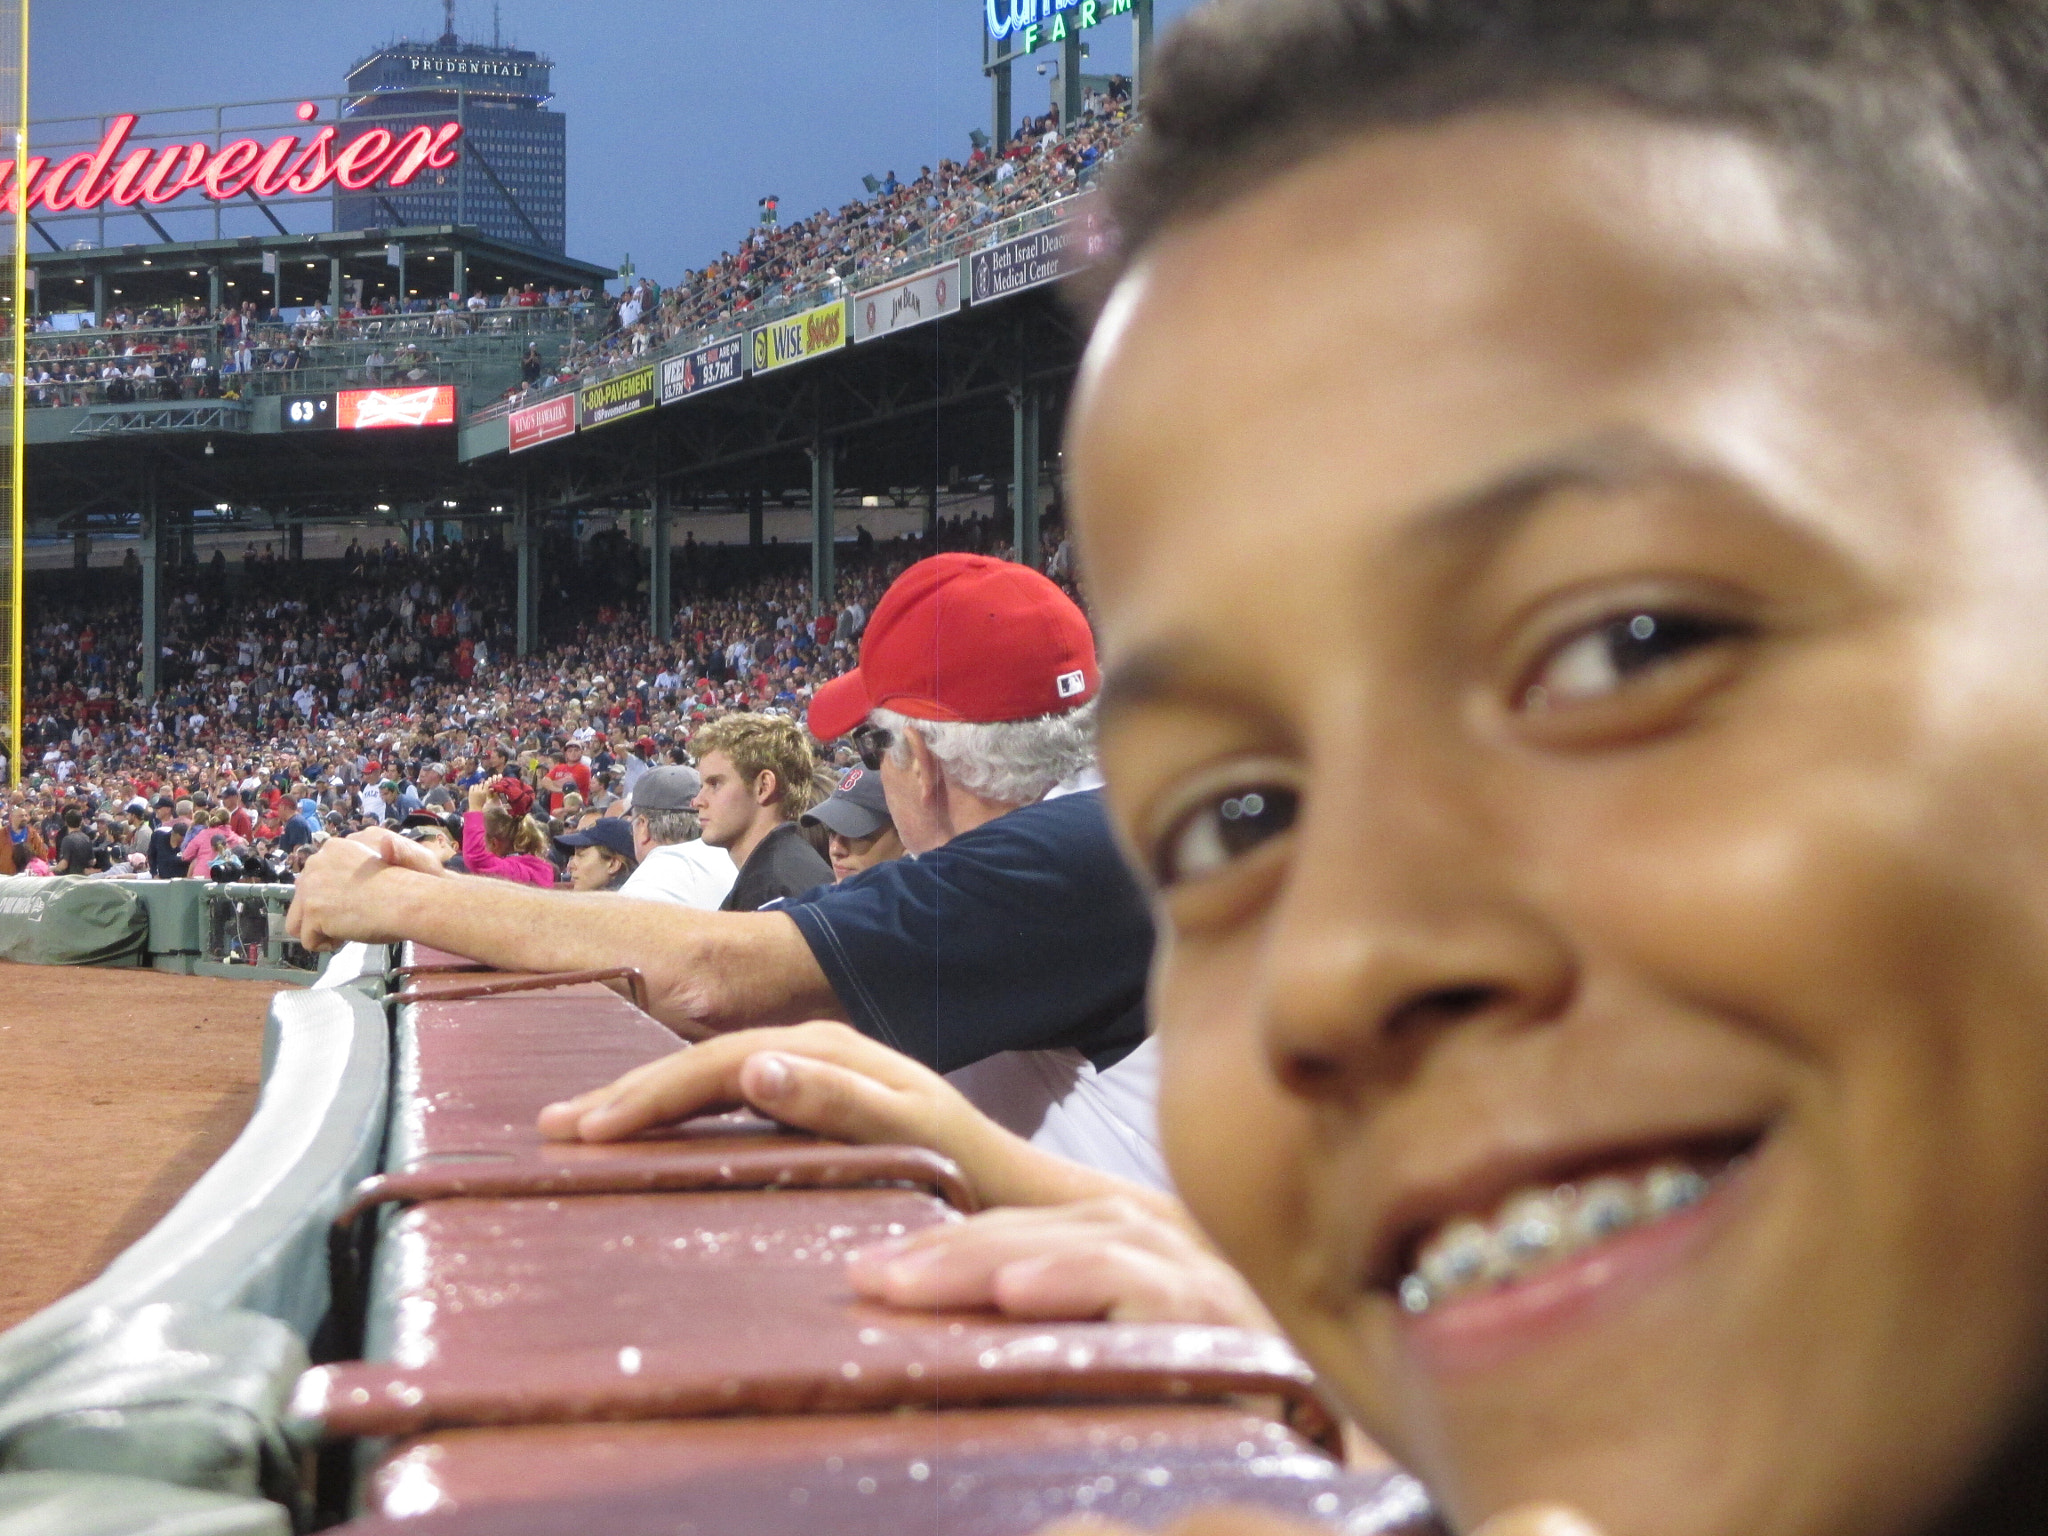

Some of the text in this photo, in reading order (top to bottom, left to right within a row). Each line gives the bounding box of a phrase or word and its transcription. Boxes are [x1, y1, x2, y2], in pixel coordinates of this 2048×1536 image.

[411, 59, 522, 77] PRUDENTIAL
[992, 250, 1012, 271] Beth
[1014, 236, 1038, 264] Israel
[993, 258, 1059, 294] Medical Center
[697, 352, 707, 367] THE
[719, 344, 730, 359] ARE
[730, 340, 740, 356] ON
[773, 324, 804, 362] WISE
[582, 370, 654, 412] 1-800-PAVEMENT
[515, 401, 567, 434] KING'S HAWAIIAN
[593, 399, 641, 422] USPavement.com
[838, 769, 864, 792] B
